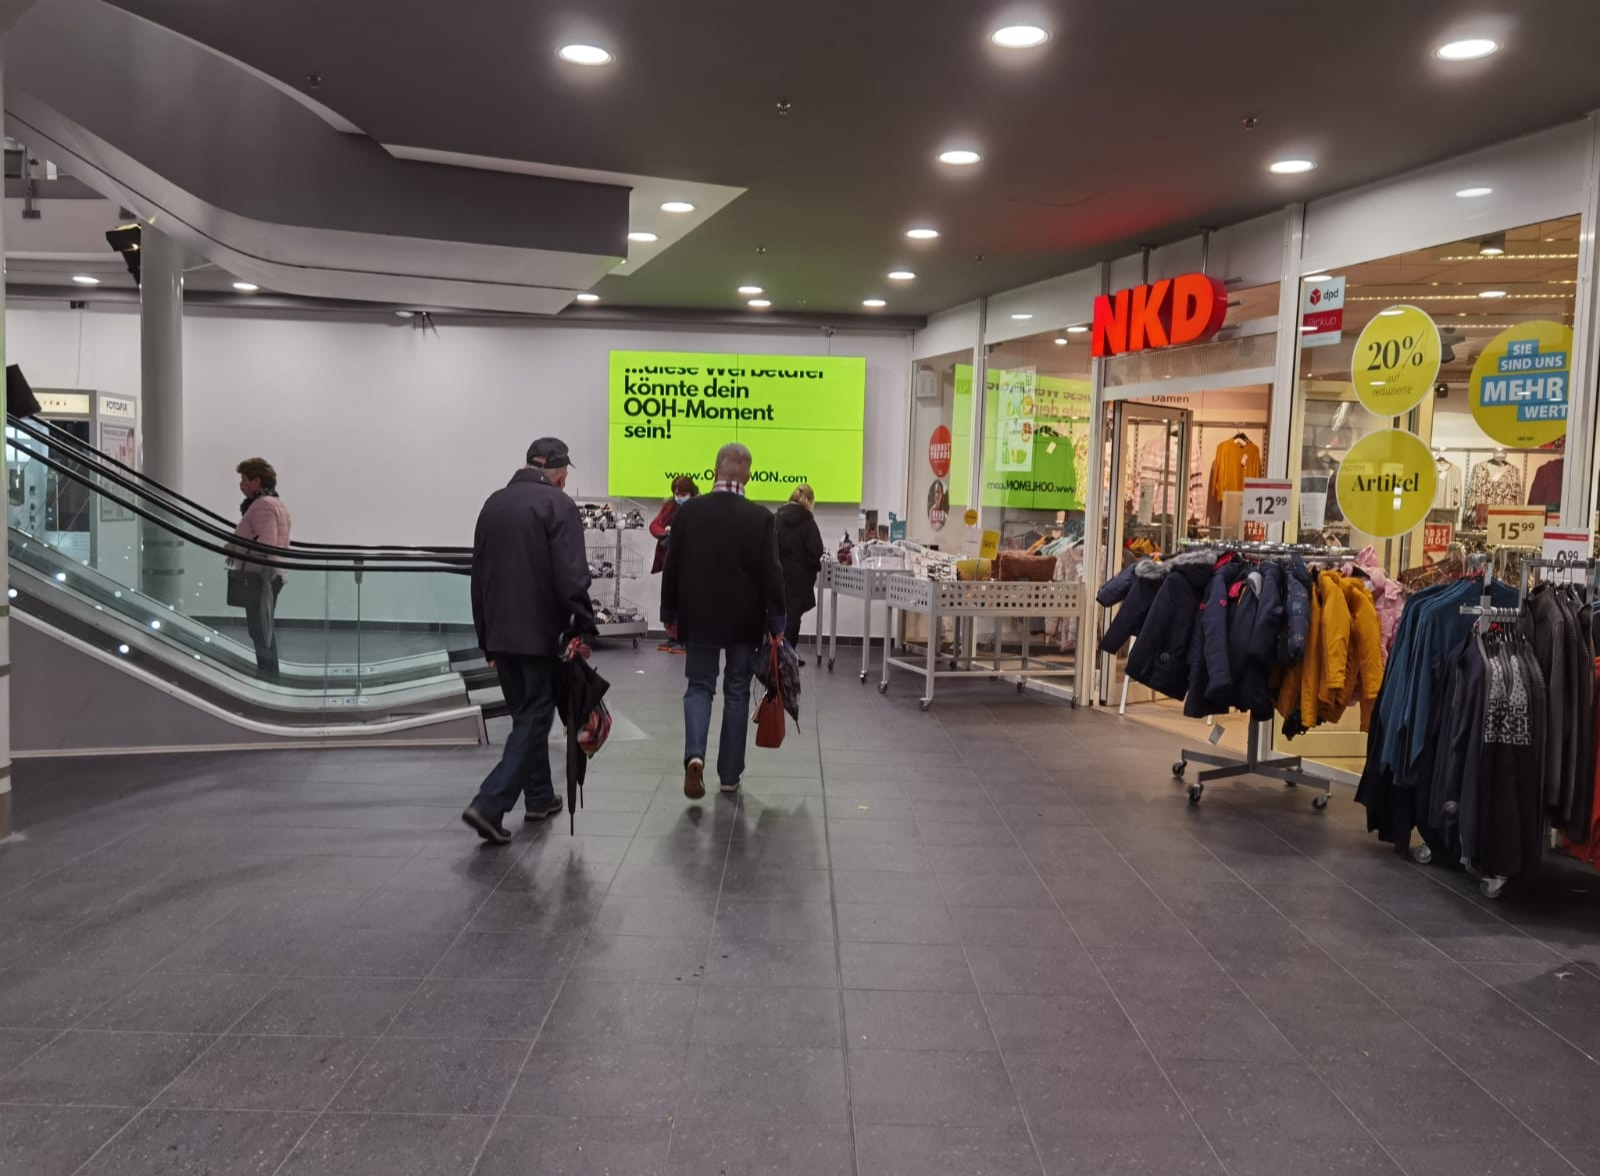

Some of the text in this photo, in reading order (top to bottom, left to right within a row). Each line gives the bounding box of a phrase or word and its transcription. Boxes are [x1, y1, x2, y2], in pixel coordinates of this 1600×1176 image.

[1323, 288, 1339, 301] dpd
[1091, 272, 1227, 358] NKD
[1366, 331, 1424, 371] 20%
[1513, 344, 1533, 356] SIE
[1501, 356, 1563, 371] SIND UNS
[1386, 371, 1400, 383] auf
[624, 375, 749, 398] könnte dein
[1372, 386, 1413, 397] reduzierte
[1483, 377, 1564, 402] MEHR
[1152, 395, 1190, 403] Damen
[623, 397, 774, 421] OOH-Moment
[1525, 405, 1568, 418] WERT
[624, 419, 671, 439] sein!
[1352, 473, 1419, 492] Artikel
